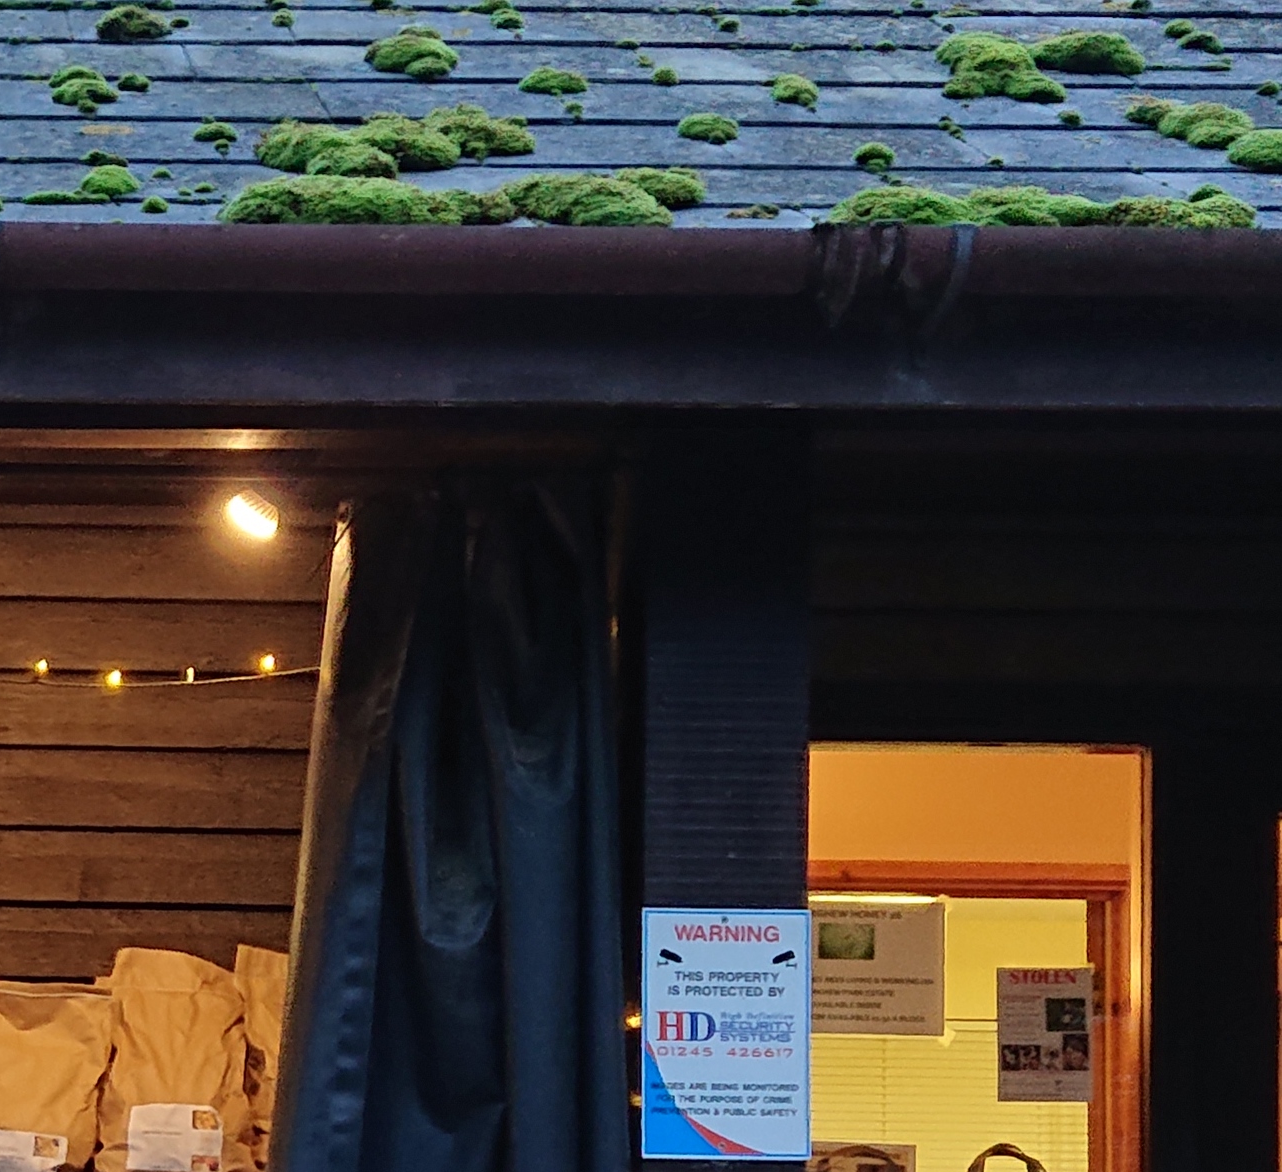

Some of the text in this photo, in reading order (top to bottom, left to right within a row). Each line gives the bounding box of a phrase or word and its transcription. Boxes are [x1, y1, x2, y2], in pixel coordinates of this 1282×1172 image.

[674, 924, 781, 943] WARNING
[674, 971, 780, 983] THIS PROPERTY
[1009, 970, 1077, 985] STOLEN
[667, 985, 786, 998] IS PROTECTED BY
[655, 1010, 717, 1042] HD
[720, 1020, 796, 1032] SECURITY
[720, 1032, 793, 1043] SYSTEMS
[656, 1046, 714, 1058] 01245
[688, 1082, 708, 1091] ARE
[710, 1083, 740, 1092] BEING
[742, 1083, 800, 1093] MONITORED
[678, 1095, 696, 1104] THE
[699, 1095, 744, 1104] PURPOSE
[746, 1095, 760, 1104] OF
[722, 1108, 758, 1117] PUBLIC
[759, 1108, 799, 1118] SAFETY
